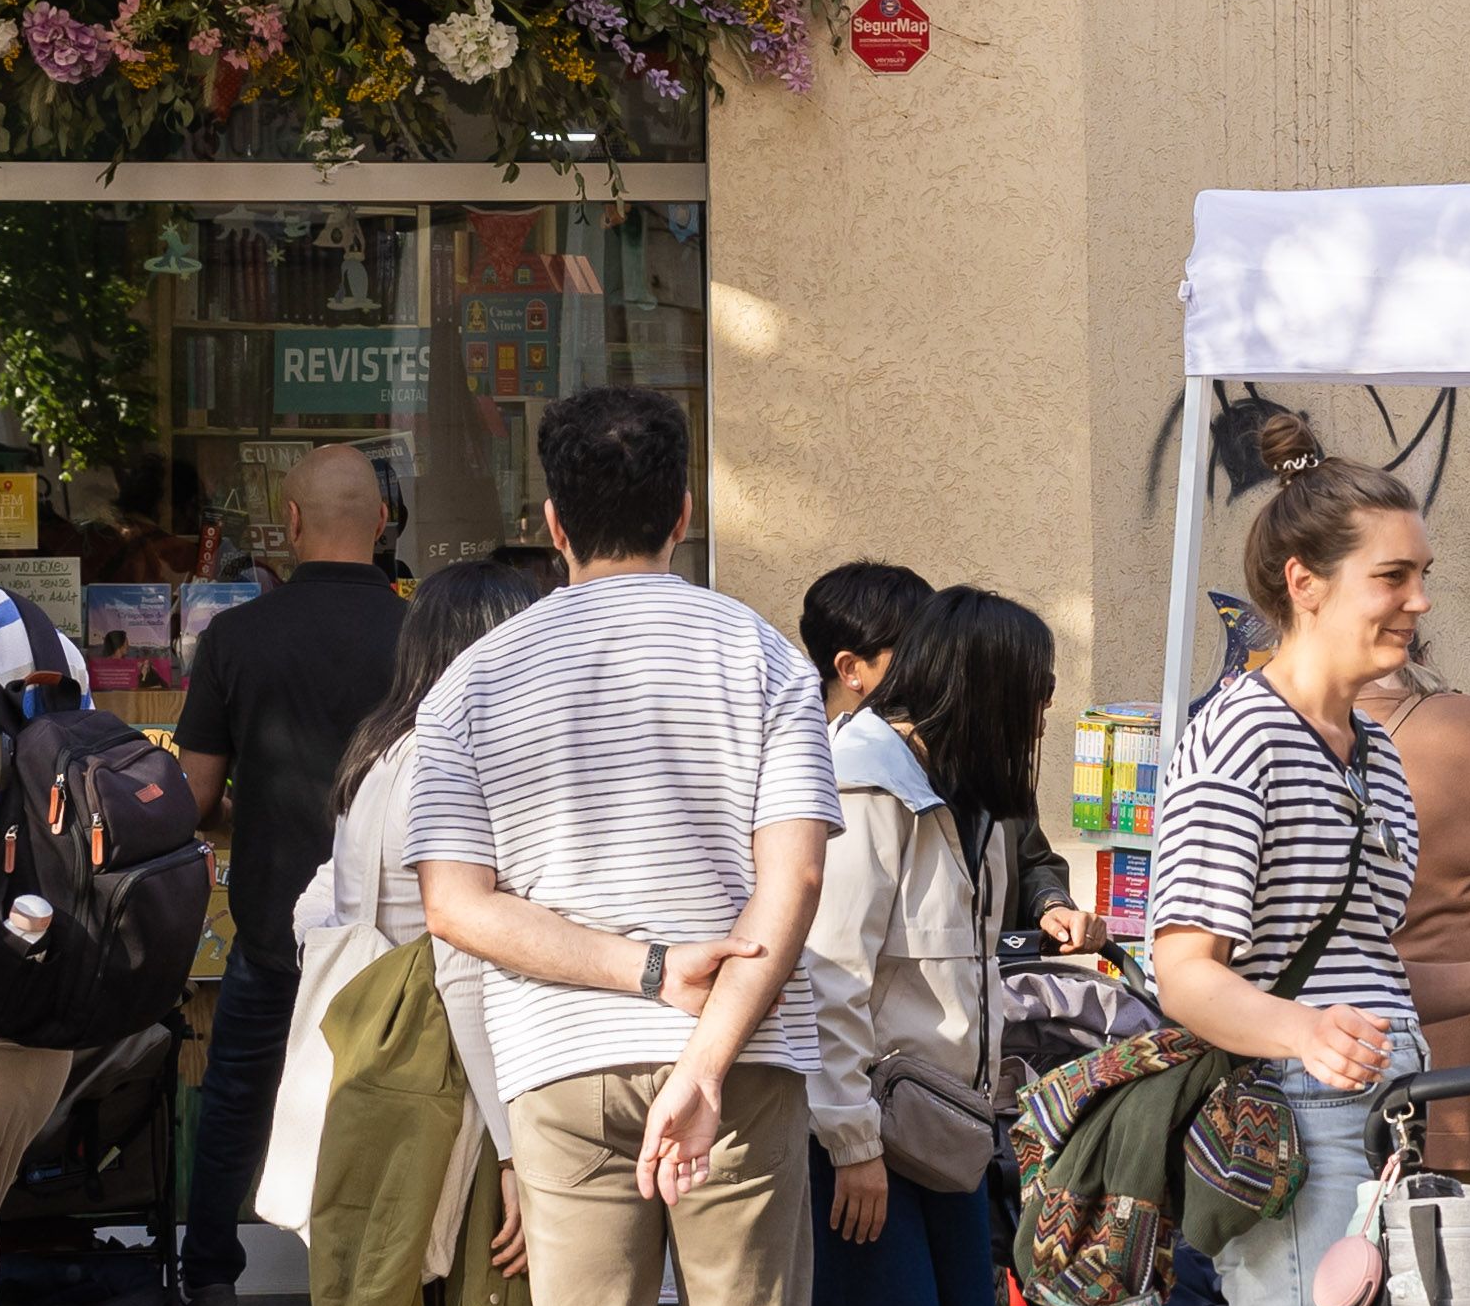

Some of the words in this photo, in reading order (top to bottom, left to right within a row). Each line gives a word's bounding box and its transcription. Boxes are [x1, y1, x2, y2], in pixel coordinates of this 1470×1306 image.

[853, 18, 928, 35] SegurMap
[490, 306, 513, 318] Casa
[284, 346, 431, 383] REVISTES
[381, 389, 395, 402] EN
[429, 543, 449, 558] SE
[15, 562, 30, 573] NO
